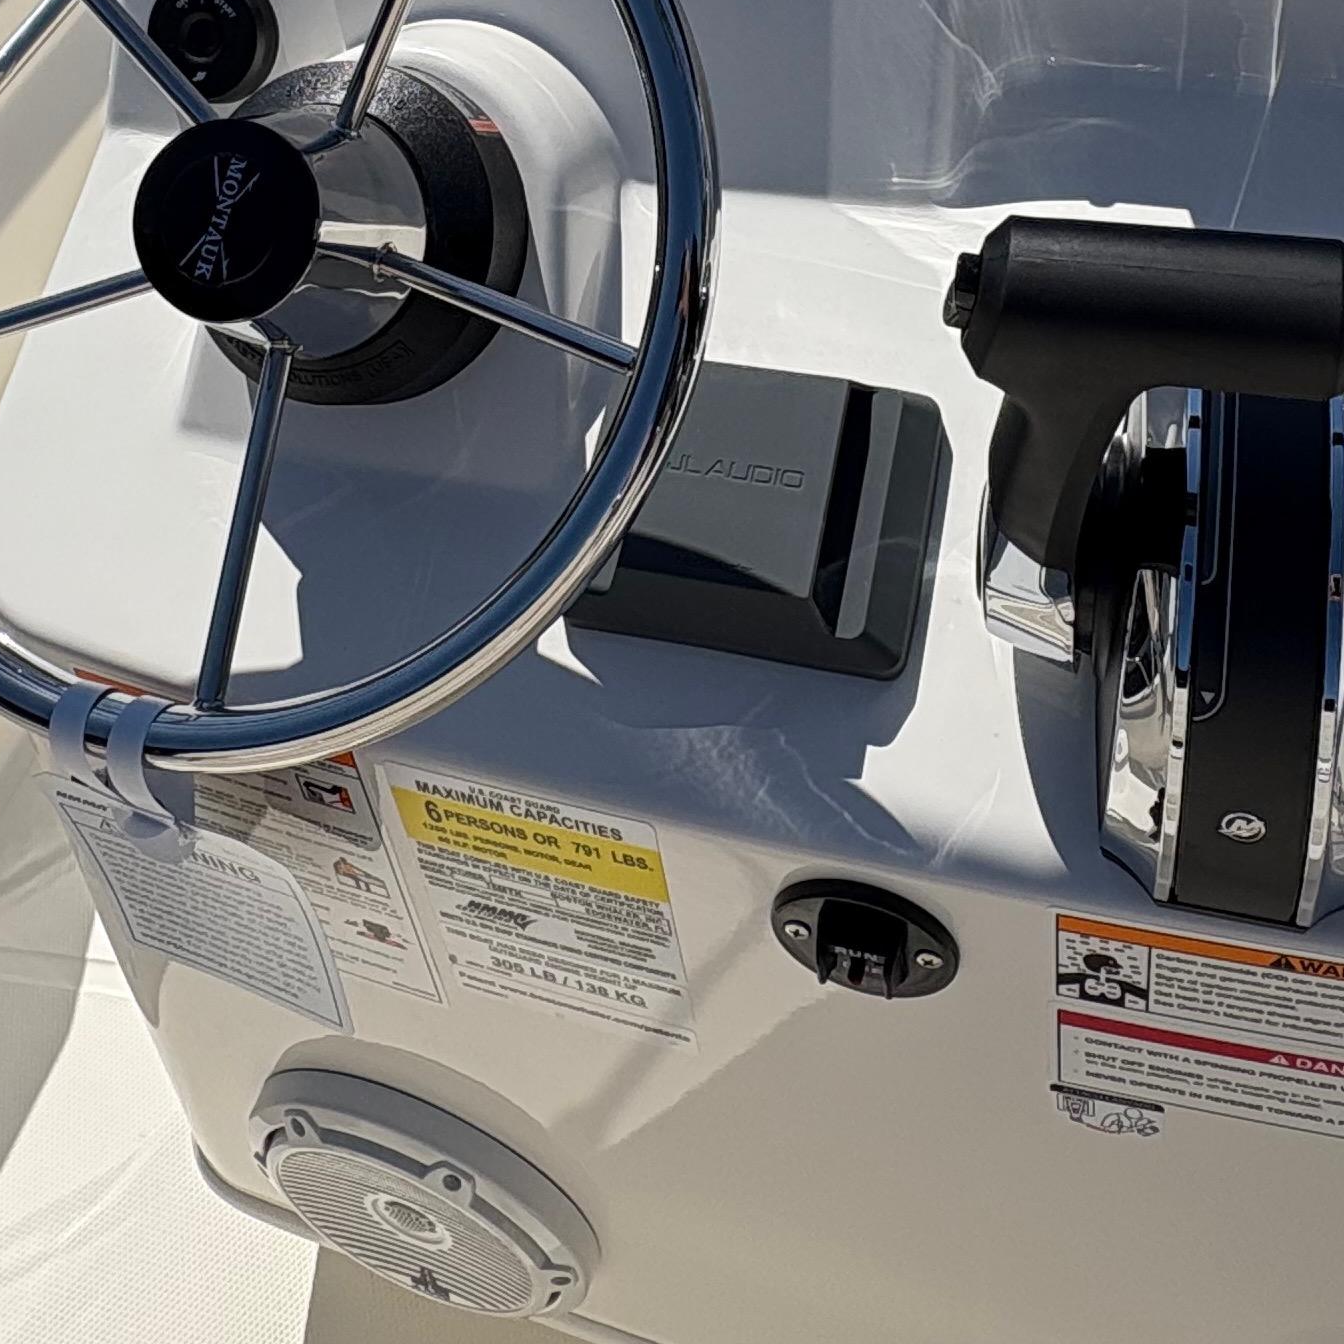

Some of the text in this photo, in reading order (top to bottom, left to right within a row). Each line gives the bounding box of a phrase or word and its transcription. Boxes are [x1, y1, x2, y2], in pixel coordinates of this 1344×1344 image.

[193, 156, 248, 281] MONTAUK
[665, 453, 807, 490] JL AUDIO
[414, 779, 623, 842] MAXIMUM CAPACITIES
[488, 790, 522, 805] COAST
[523, 798, 560, 814] GUARD
[422, 798, 443, 824] 6
[443, 808, 528, 841] PERSONS
[531, 830, 560, 849] OR
[570, 840, 601, 860] 791
[192, 849, 261, 882] NING
[528, 965, 557, 984] LB
[613, 988, 648, 1009] KG
